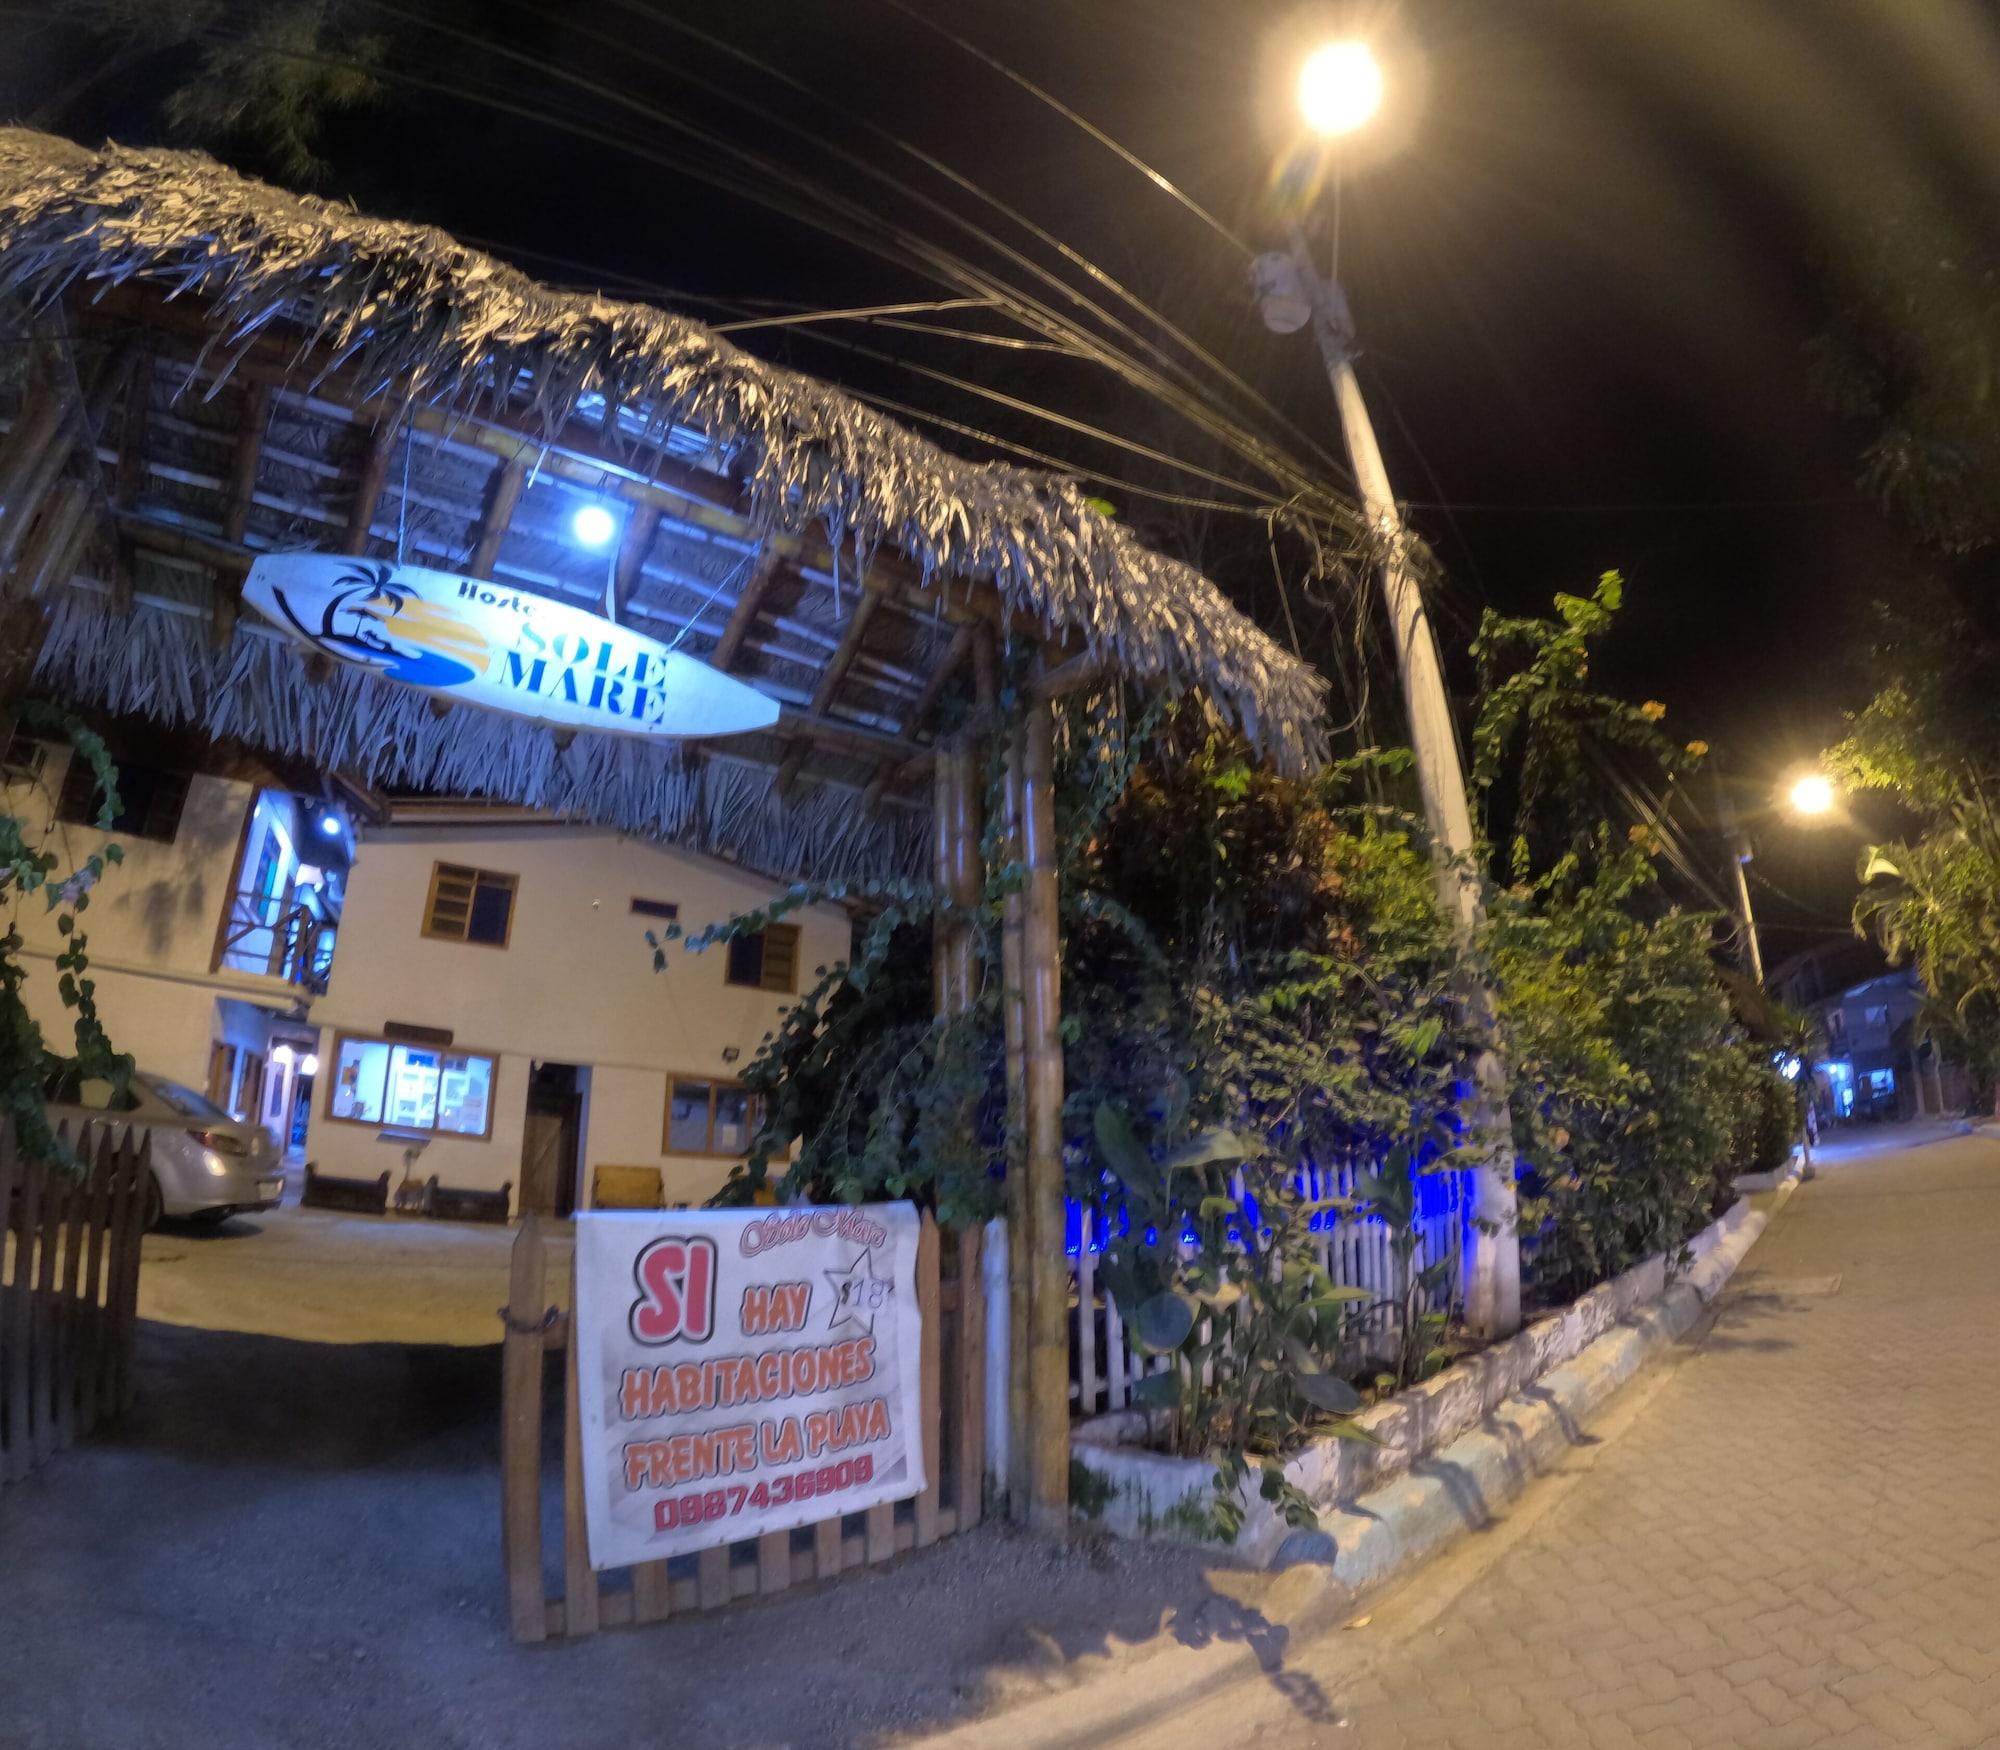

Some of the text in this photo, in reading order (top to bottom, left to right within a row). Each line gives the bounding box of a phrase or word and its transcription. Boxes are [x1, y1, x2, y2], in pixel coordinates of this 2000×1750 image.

[499, 651, 667, 725] MARE
[515, 622, 667, 689] SOLE
[629, 1235, 812, 1345] SI HAY
[618, 1337, 876, 1421] HABITACIONES
[623, 1398, 891, 1492] FRENTE LA PLAYA
[654, 1455, 874, 1532] 0987436909
